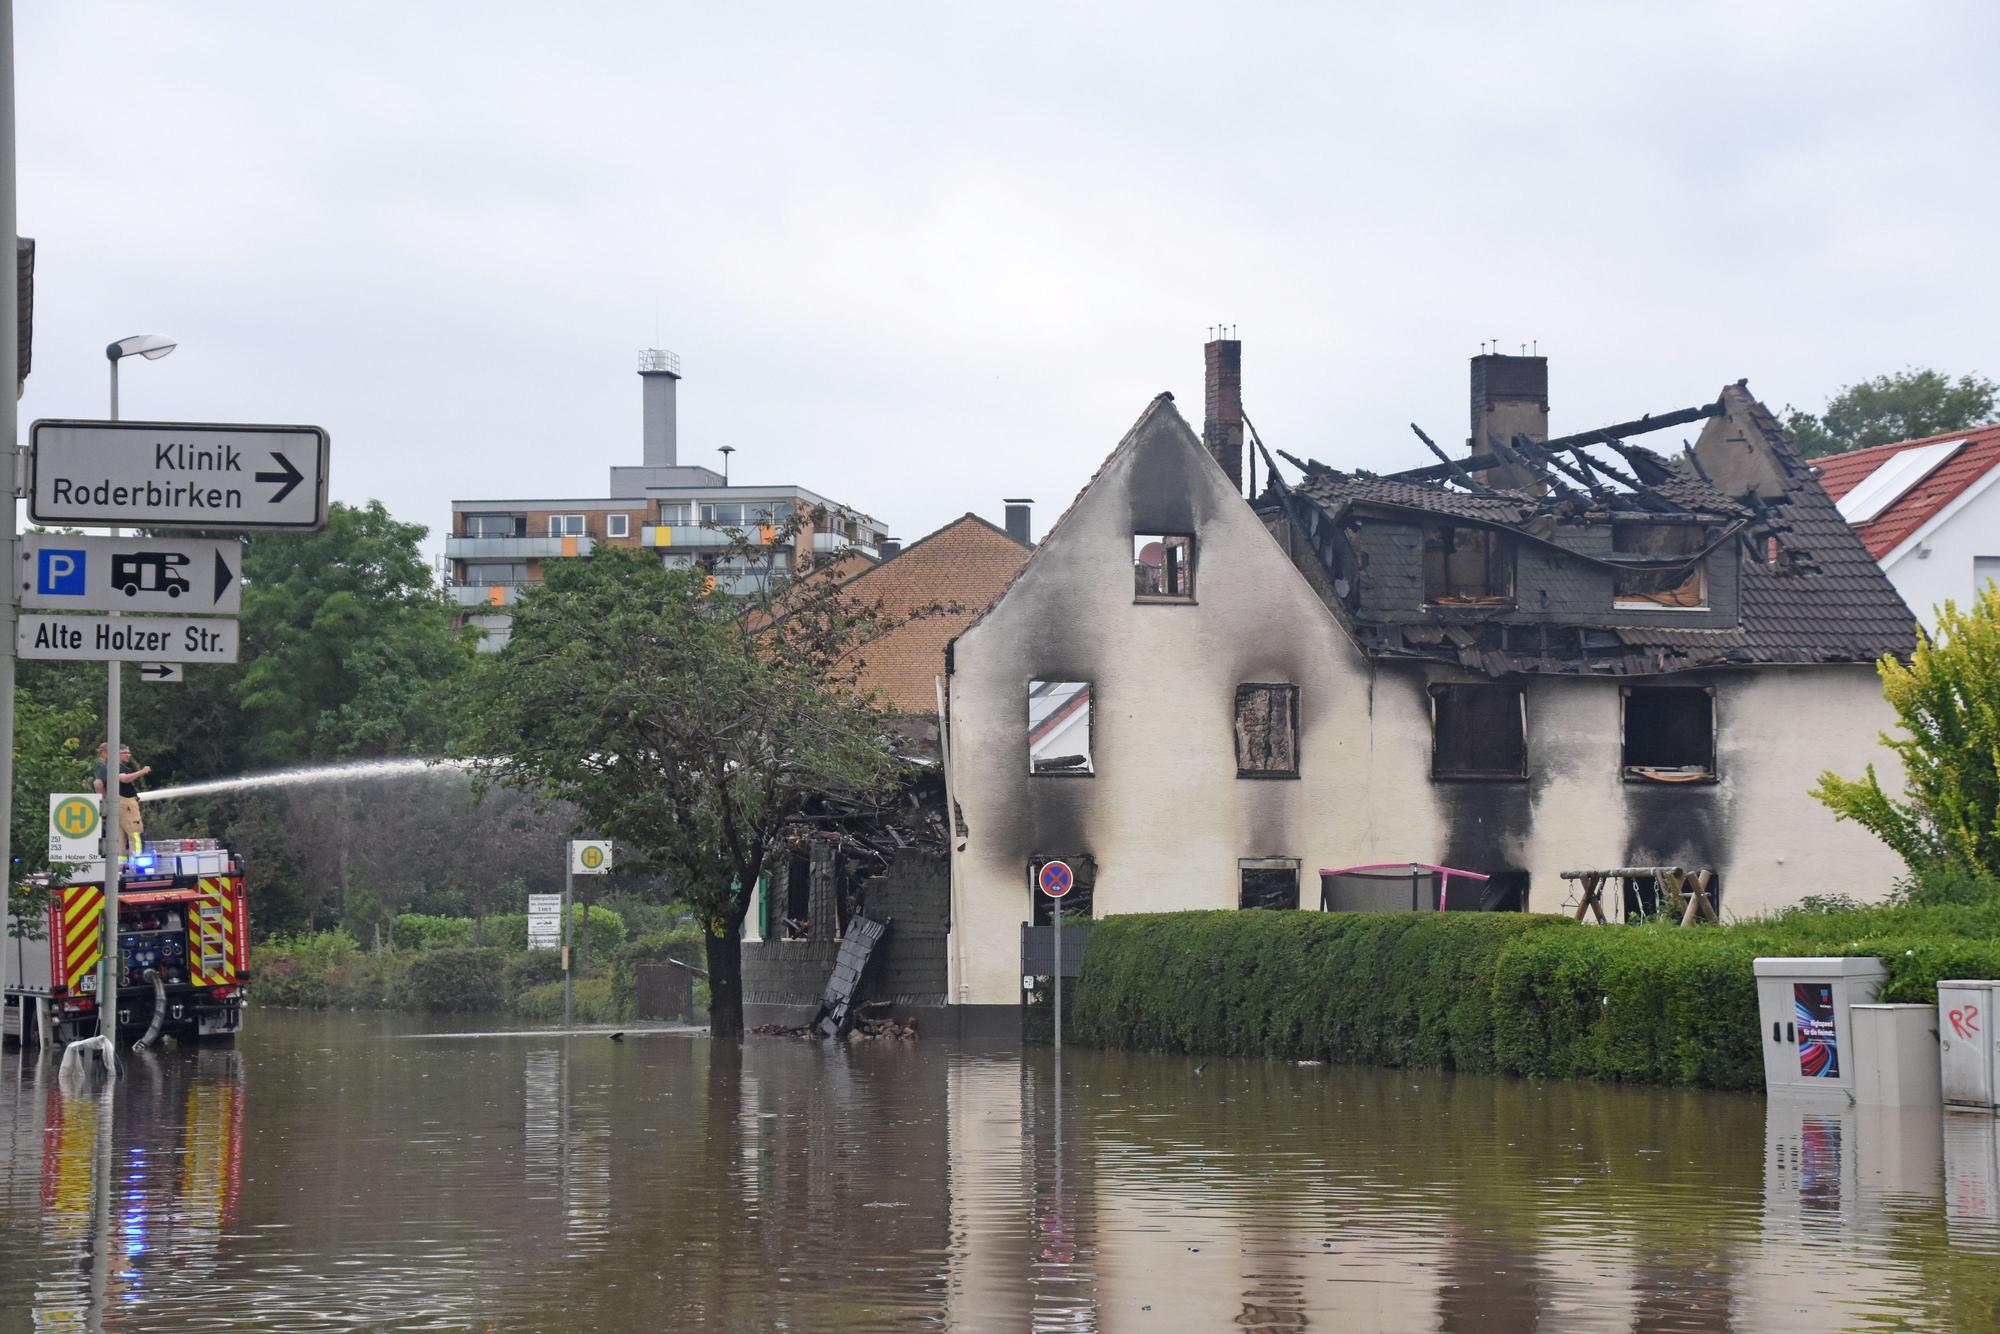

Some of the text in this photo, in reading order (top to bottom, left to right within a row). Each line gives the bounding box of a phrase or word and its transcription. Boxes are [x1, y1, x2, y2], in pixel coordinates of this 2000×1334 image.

[155, 443, 242, 471] Klinik
[53, 478, 241, 508] Roderbirken
[48, 555, 75, 589] P
[34, 622, 224, 652] Alte Holzer Str.
[66, 806, 87, 829] H
